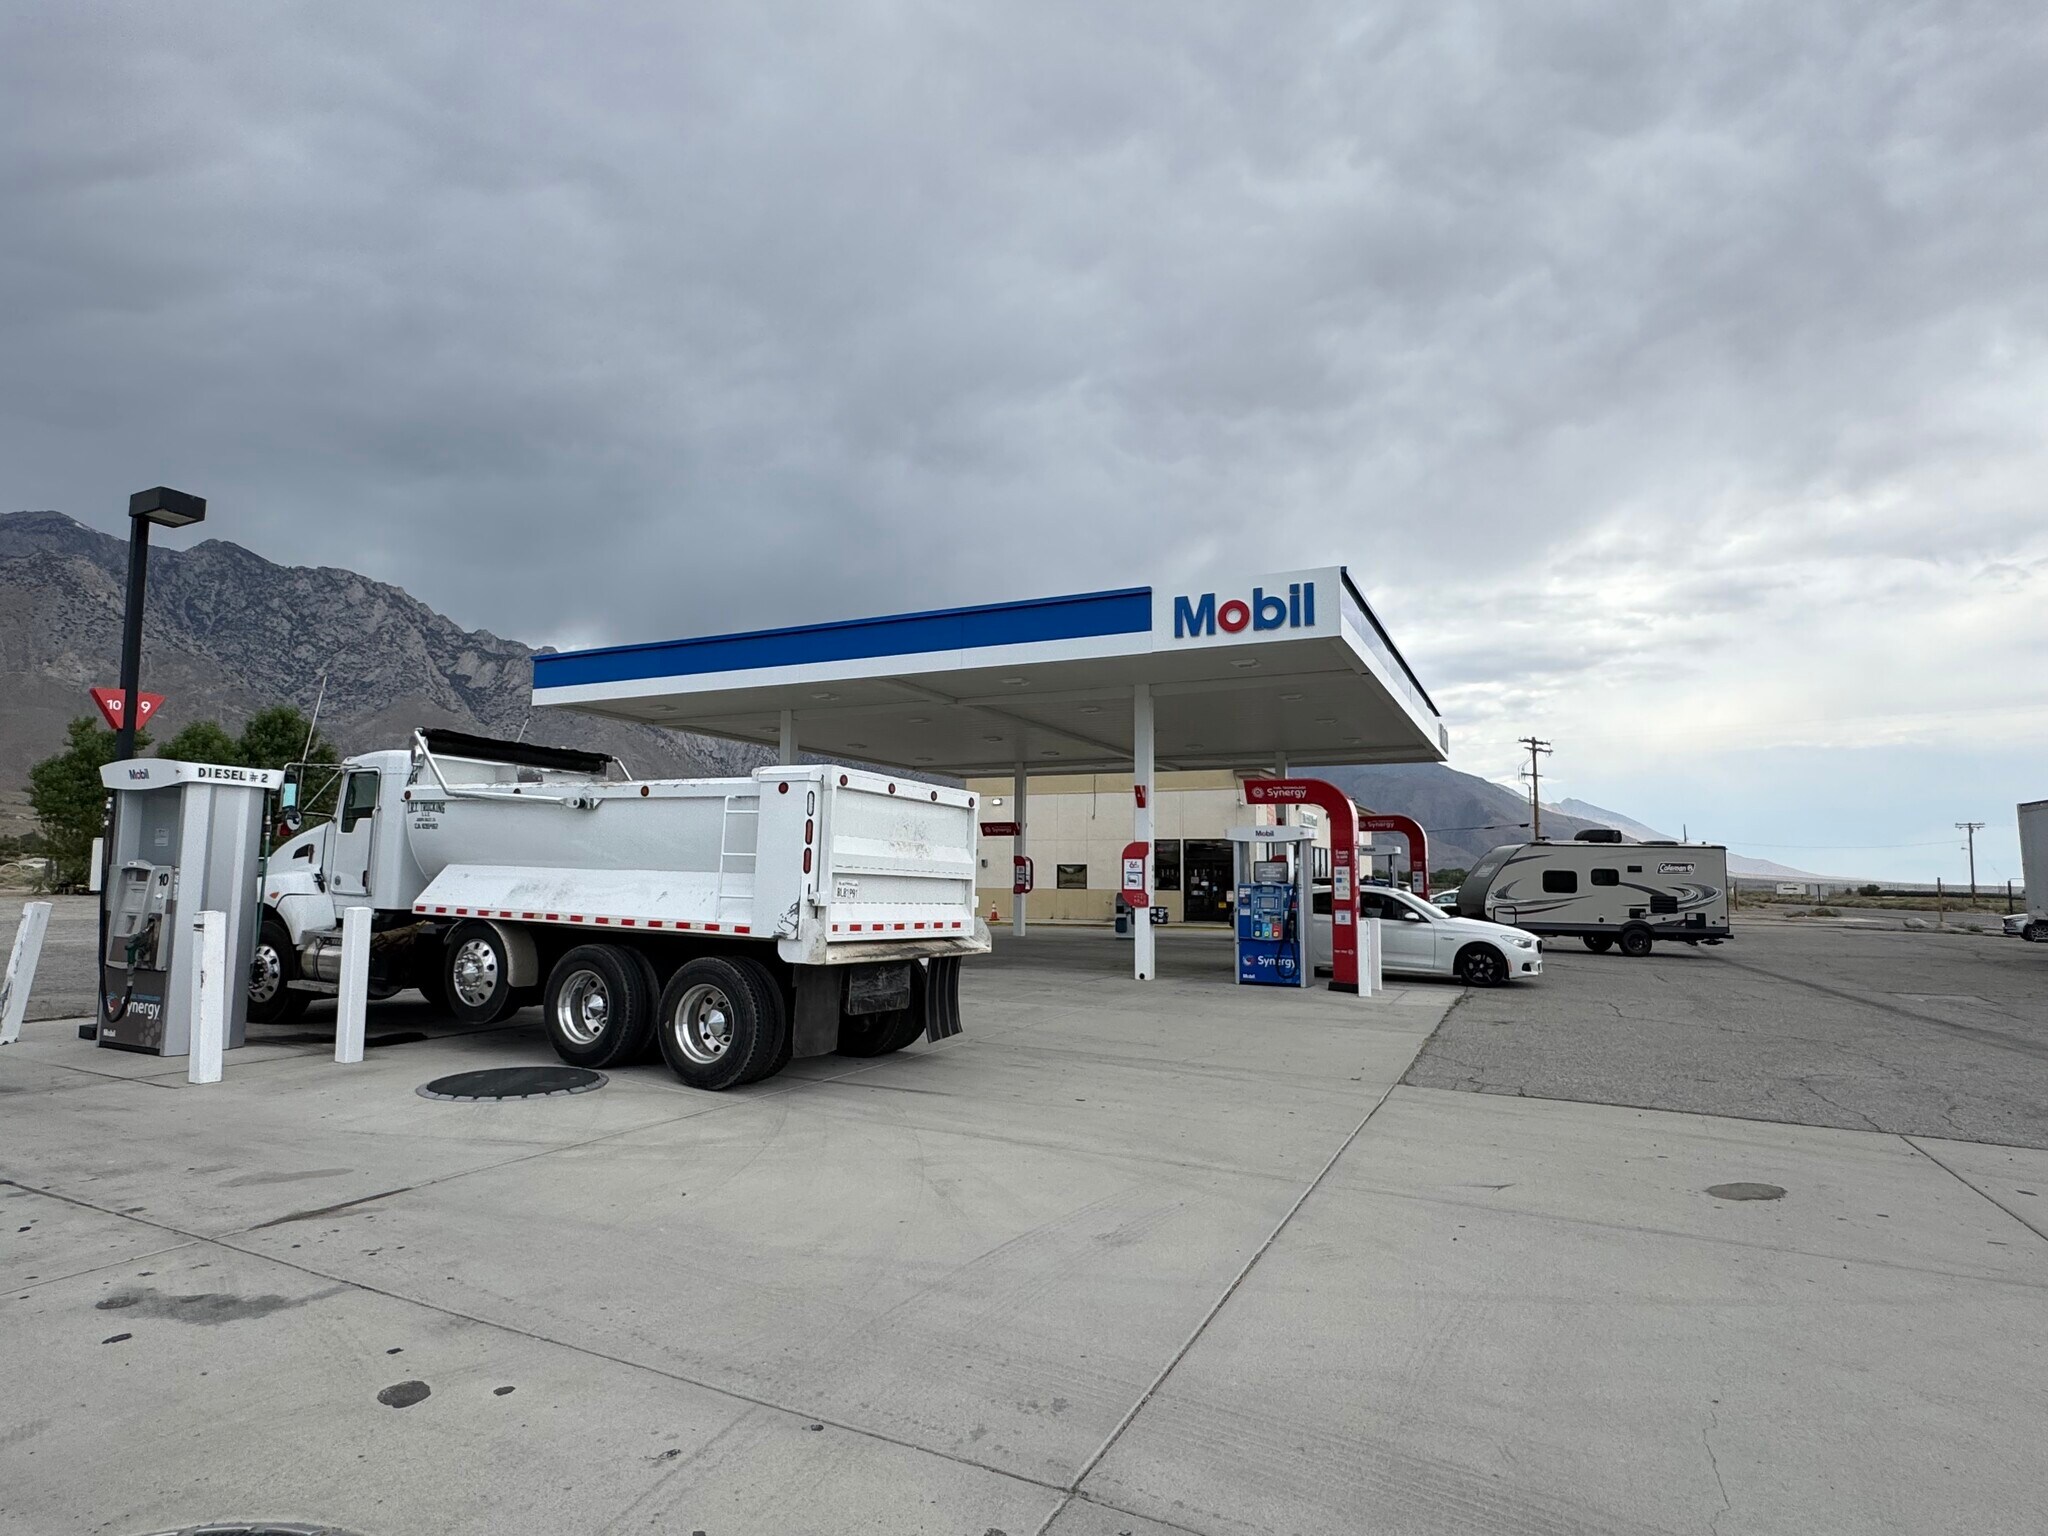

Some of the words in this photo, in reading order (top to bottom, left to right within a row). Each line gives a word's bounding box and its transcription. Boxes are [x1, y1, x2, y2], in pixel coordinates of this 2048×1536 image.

[1174, 582, 1315, 638] Mobil
[106, 699, 122, 711] 10
[140, 701, 151, 713] 9
[129, 769, 149, 780] Mobil
[198, 767, 246, 781] DIESEL
[1267, 787, 1307, 798] Synergy
[1660, 863, 1687, 872] Coleman
[158, 873, 169, 886] 10
